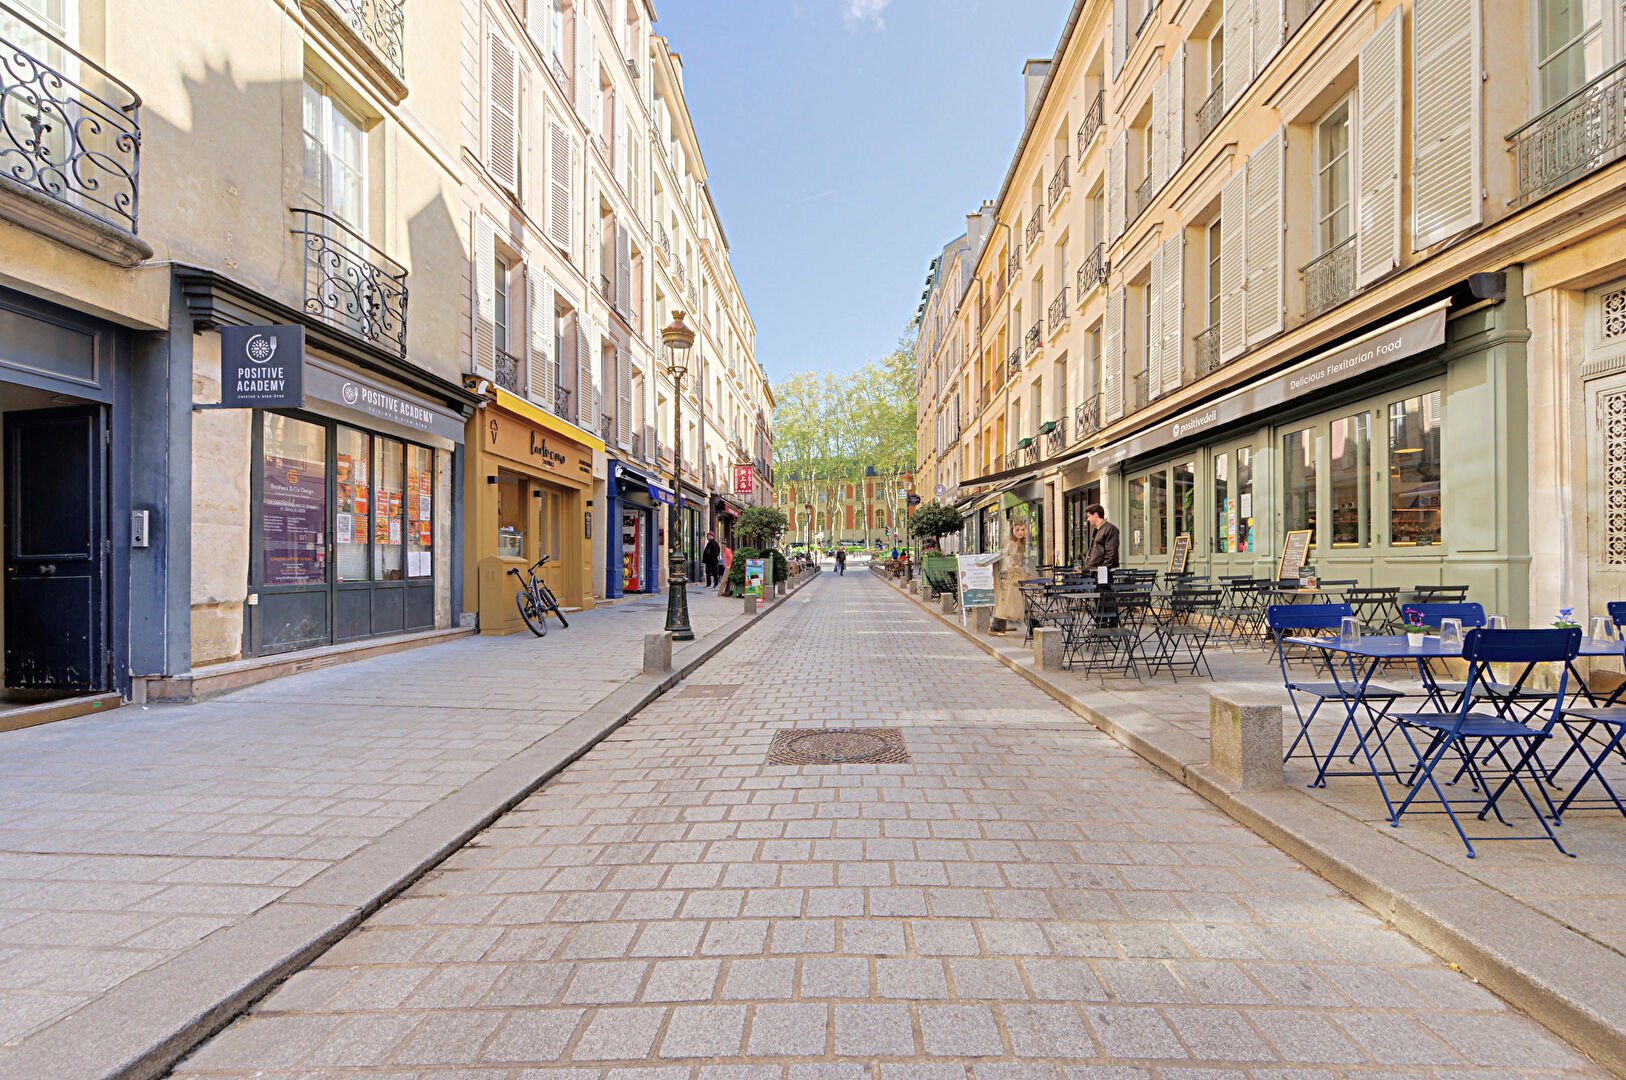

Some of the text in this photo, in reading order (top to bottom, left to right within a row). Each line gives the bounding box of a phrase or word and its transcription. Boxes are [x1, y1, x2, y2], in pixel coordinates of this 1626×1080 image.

[238, 367, 284, 379] POSITIVE
[1290, 337, 1402, 390] Delicious Flexitarian Food
[236, 380, 285, 391] ACADEMY
[361, 387, 433, 424] POSITIVE ACADEMY
[1180, 409, 1217, 435] positivedeli
[301, 487, 315, 495] Design
